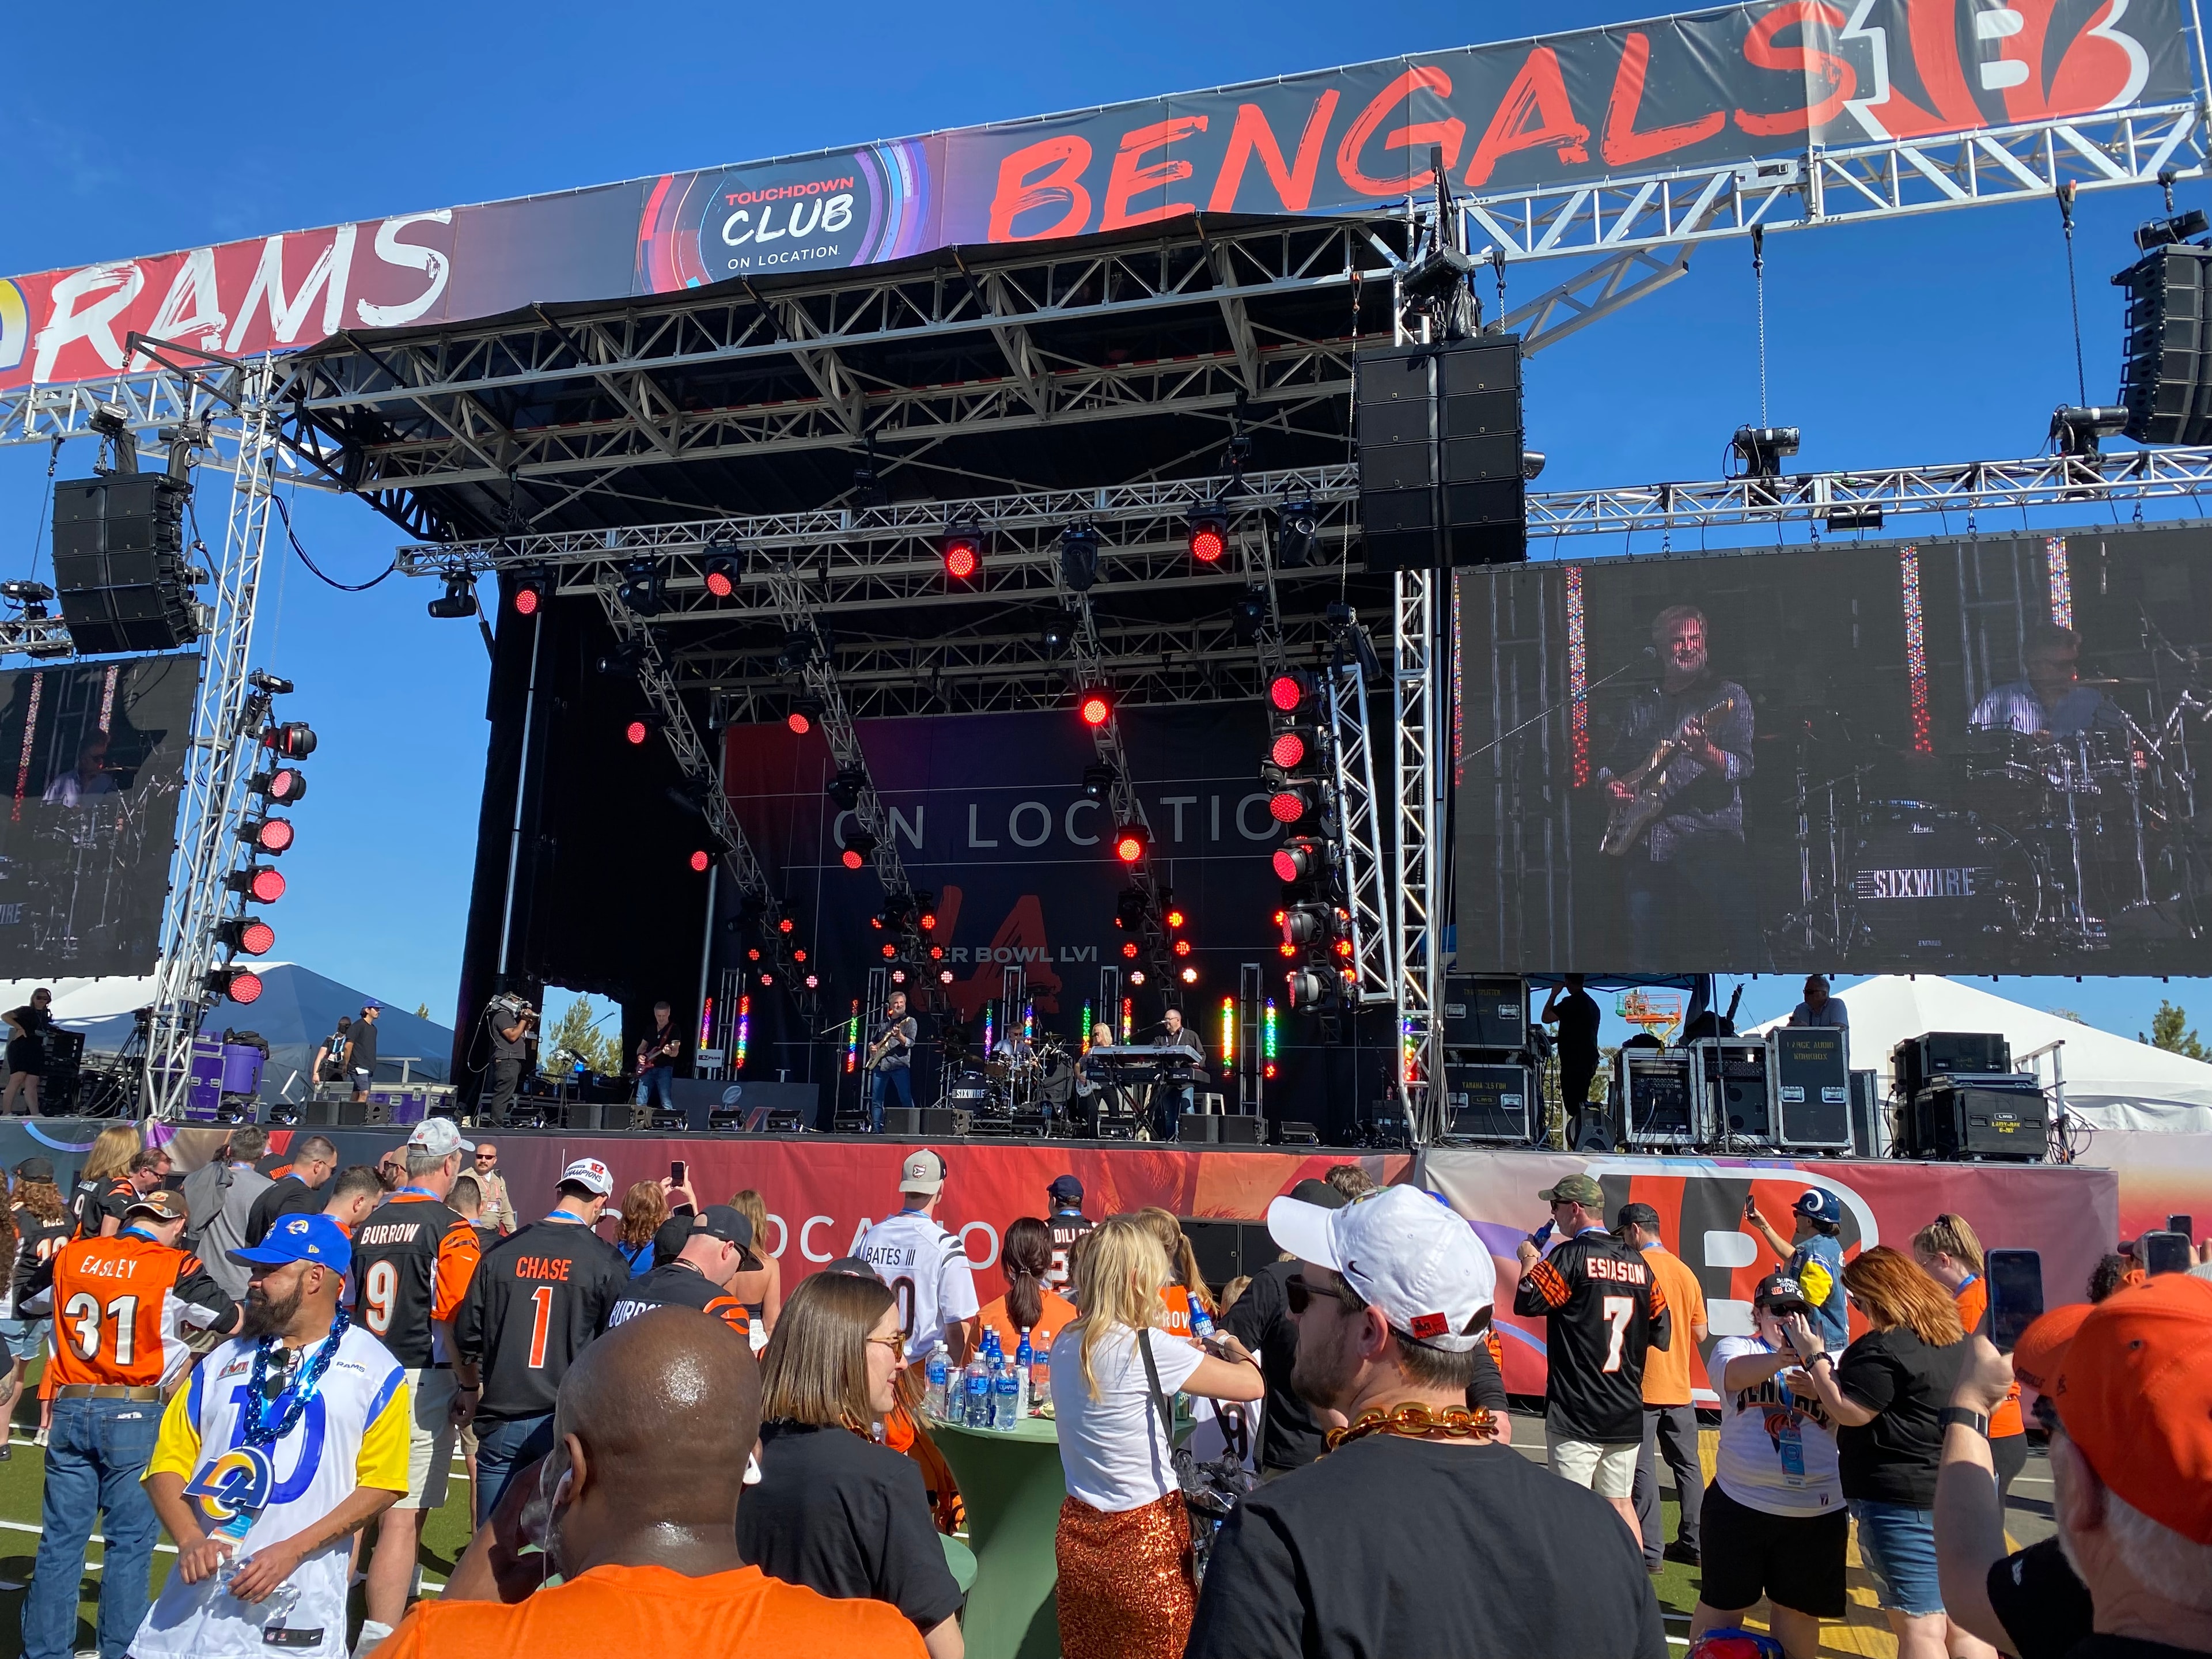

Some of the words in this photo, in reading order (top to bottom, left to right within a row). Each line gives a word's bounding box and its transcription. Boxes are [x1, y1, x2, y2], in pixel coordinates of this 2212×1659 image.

[987, 0, 1857, 243] BENGALS
[724, 176, 854, 207] TOUCHDOWN
[721, 193, 854, 247] CLUB
[727, 256, 750, 270] ON
[757, 245, 839, 266] LOCATION
[32, 209, 452, 384] RAMS
[968, 793, 1338, 848] LOCATIO
[1873, 868, 1976, 897] SIXWIRE
[976, 946, 1054, 963] BOWL
[1060, 946, 1097, 962] LVI
[1813, 1041, 1834, 1049] AUDIO
[956, 1089, 984, 1099] SIXWIRE
[1462, 1081, 1483, 1089] YAMAHA
[562, 1169, 603, 1183] CHAMPIONS
[73, 1193, 85, 1219] 9
[359, 1224, 421, 1245] BURROW
[79, 1255, 138, 1279] EASLEY
[515, 1256, 572, 1282] CHASE
[865, 1247, 901, 1266] BATES
[905, 1248, 916, 1266] III
[1586, 1256, 1646, 1285] ESIASON
[1776, 1277, 1798, 1286] SUPER
[365, 1259, 399, 1336] 9
[876, 1274, 915, 1341] 0
[63, 1291, 139, 1366] 31
[527, 1286, 553, 1369] 1
[1195, 1319, 1212, 1330] BUD
[1603, 1296, 1634, 1373] 7
[335, 1361, 366, 1373] RAMS
